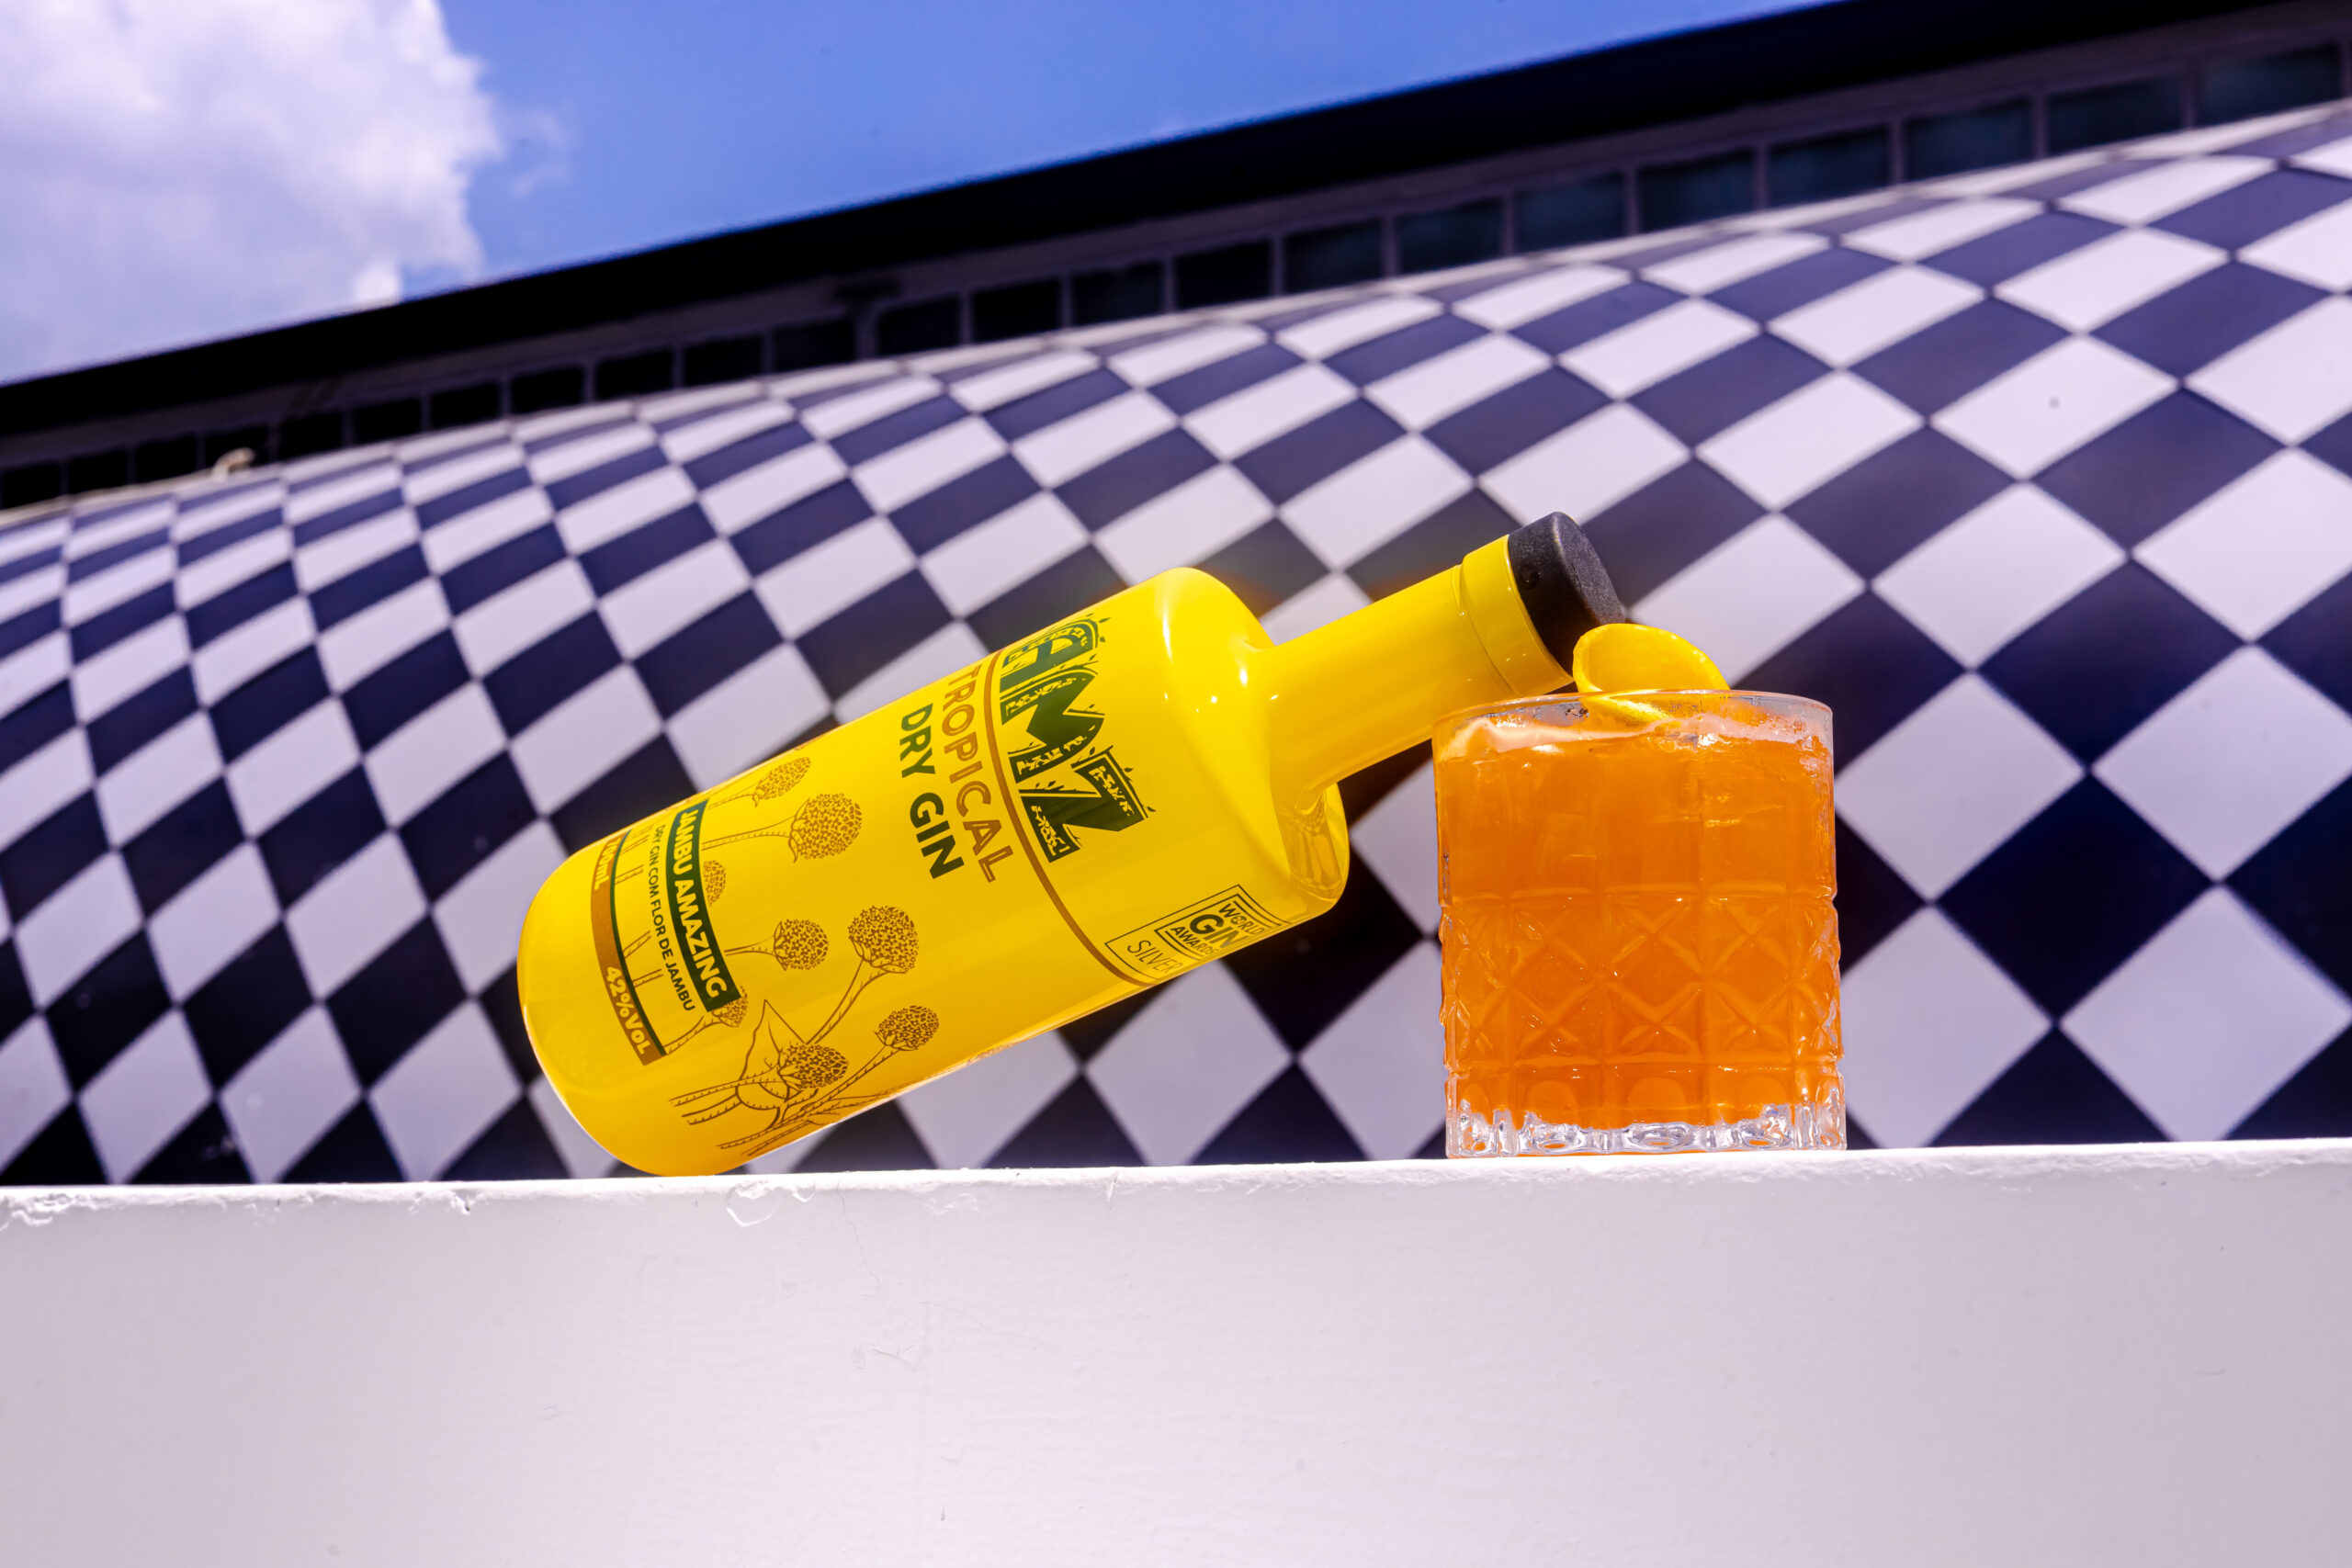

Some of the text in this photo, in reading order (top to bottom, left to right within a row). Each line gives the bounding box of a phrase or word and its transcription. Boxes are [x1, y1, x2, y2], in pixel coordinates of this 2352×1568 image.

[899, 703, 966, 880] DRY GIN
[941, 663, 1014, 884] TROPICAL
[999, 616, 1149, 863] AMZ
[648, 824, 695, 1011] DRY GIN COM FLOR DE JAMBU
[673, 808, 728, 998] JAMBU AMAZING
[1126, 940, 1184, 974] SILVER
[1170, 926, 1218, 955] AWARDS
[1189, 914, 1250, 949] GIN
[1218, 902, 1266, 936] WORLD
